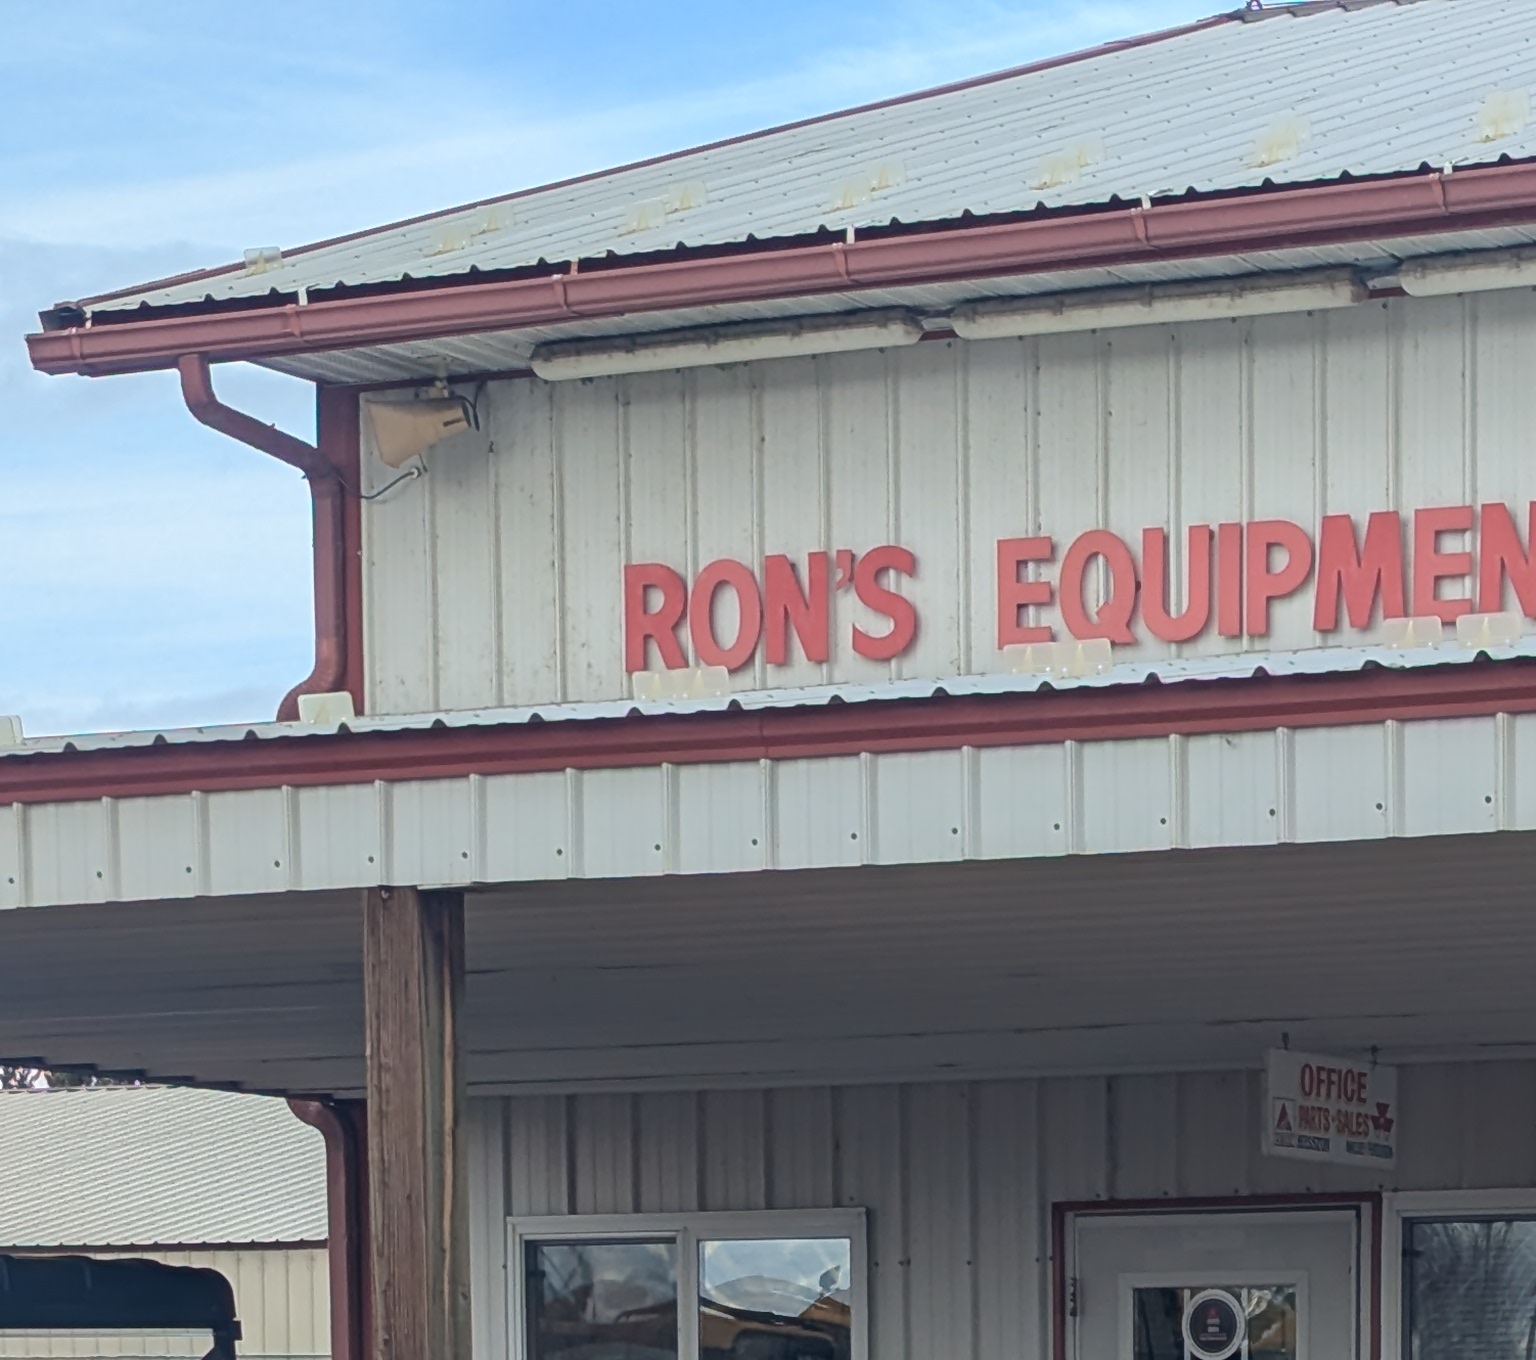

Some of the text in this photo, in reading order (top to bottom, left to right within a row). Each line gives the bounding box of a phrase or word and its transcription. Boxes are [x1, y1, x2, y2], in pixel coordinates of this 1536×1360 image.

[624, 545, 918, 673] RON'S
[1300, 1063, 1368, 1104] OFFICE
[1336, 1108, 1370, 1137] SALES
